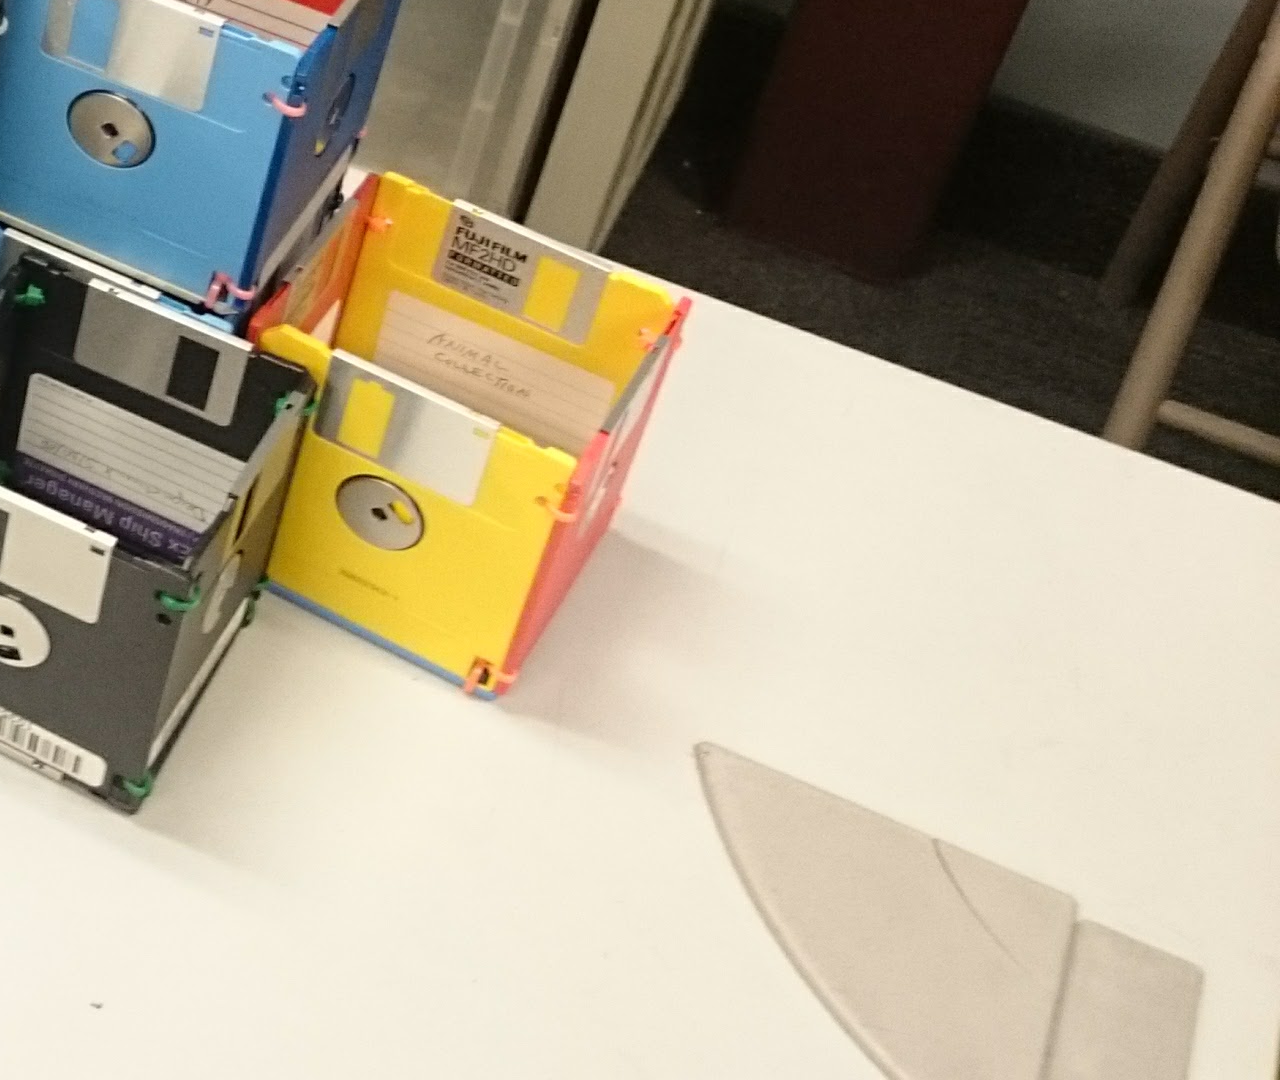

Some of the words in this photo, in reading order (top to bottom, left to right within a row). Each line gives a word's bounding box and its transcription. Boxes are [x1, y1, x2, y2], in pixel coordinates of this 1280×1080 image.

[451, 236, 517, 272] MF2HD
[455, 225, 528, 264] FUJIFILM
[426, 332, 509, 372] ANIMAL
[434, 352, 530, 397] COLLECTION
[25, 472, 116, 527] Manager
[117, 514, 165, 549] Ship
